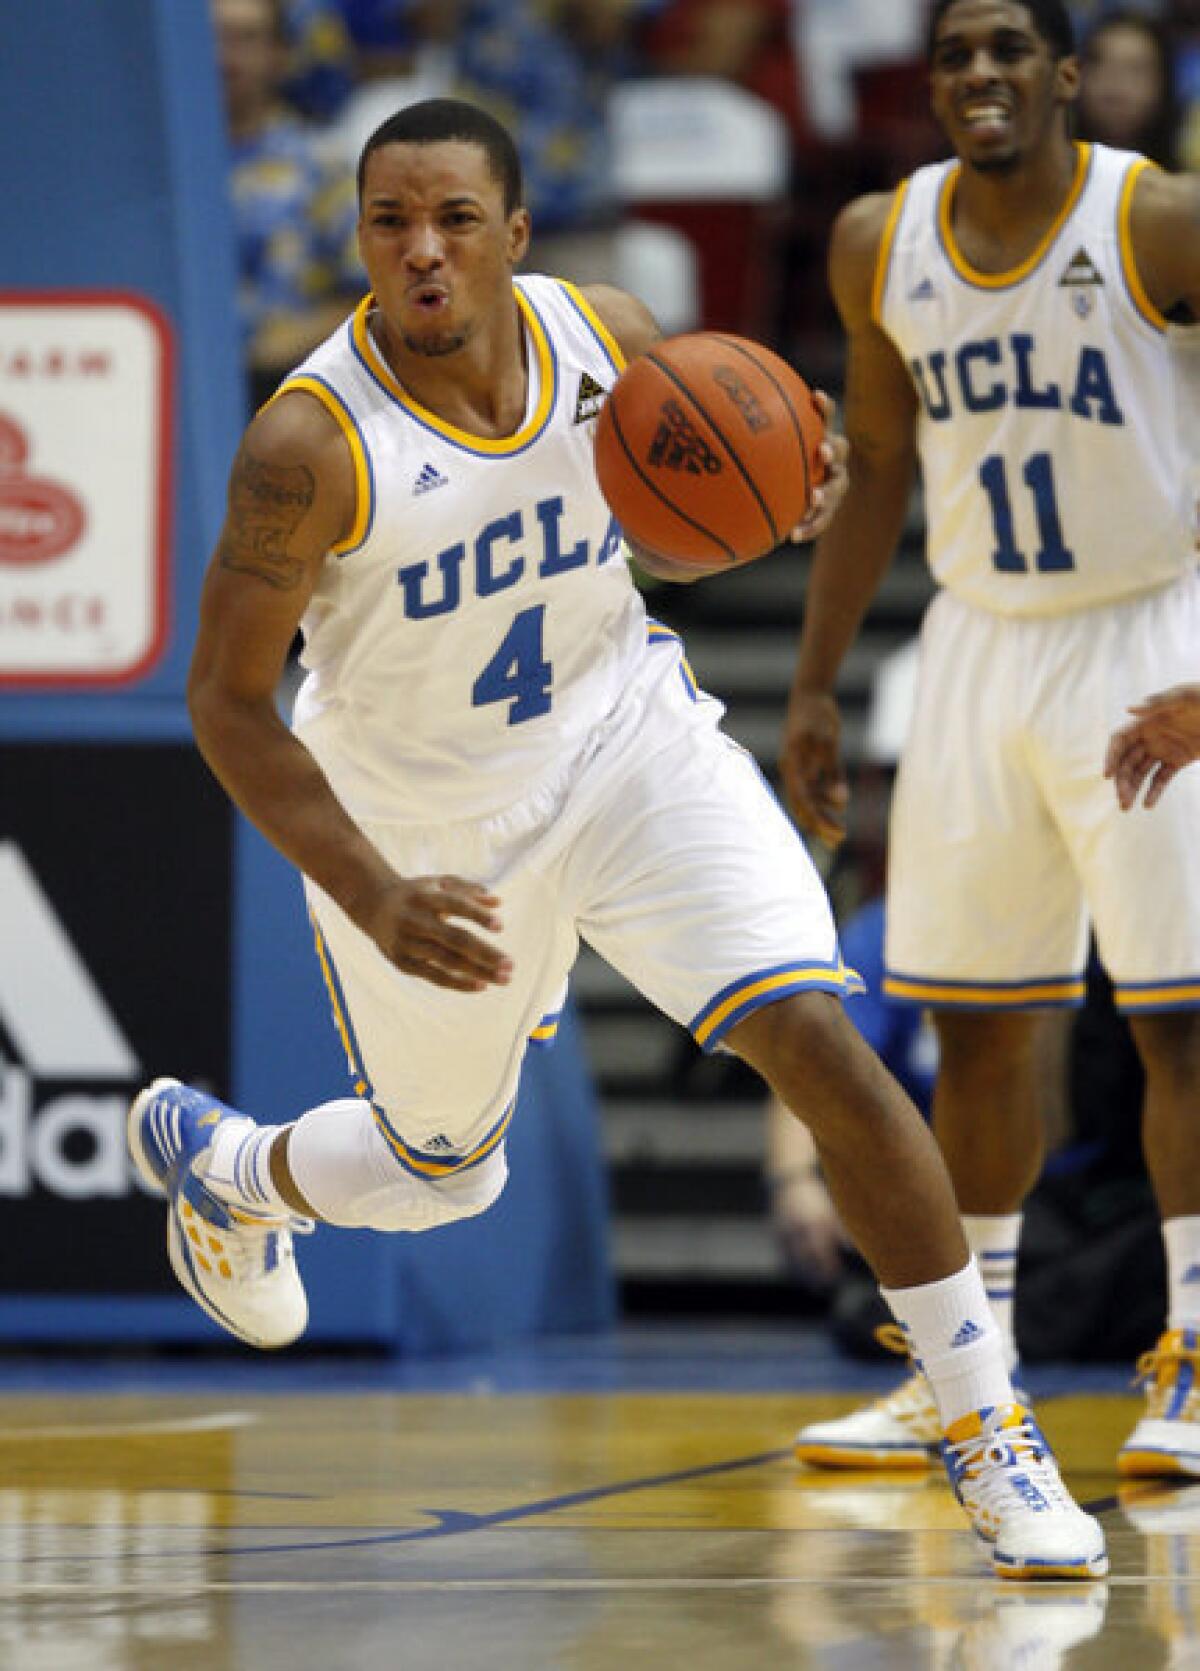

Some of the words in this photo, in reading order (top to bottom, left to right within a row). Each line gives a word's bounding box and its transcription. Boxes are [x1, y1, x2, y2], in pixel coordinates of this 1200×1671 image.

[0, 348, 112, 380] ARM
[911, 333, 1125, 426] UCLA
[977, 452, 1076, 573] 11
[471, 604, 553, 727] 4
